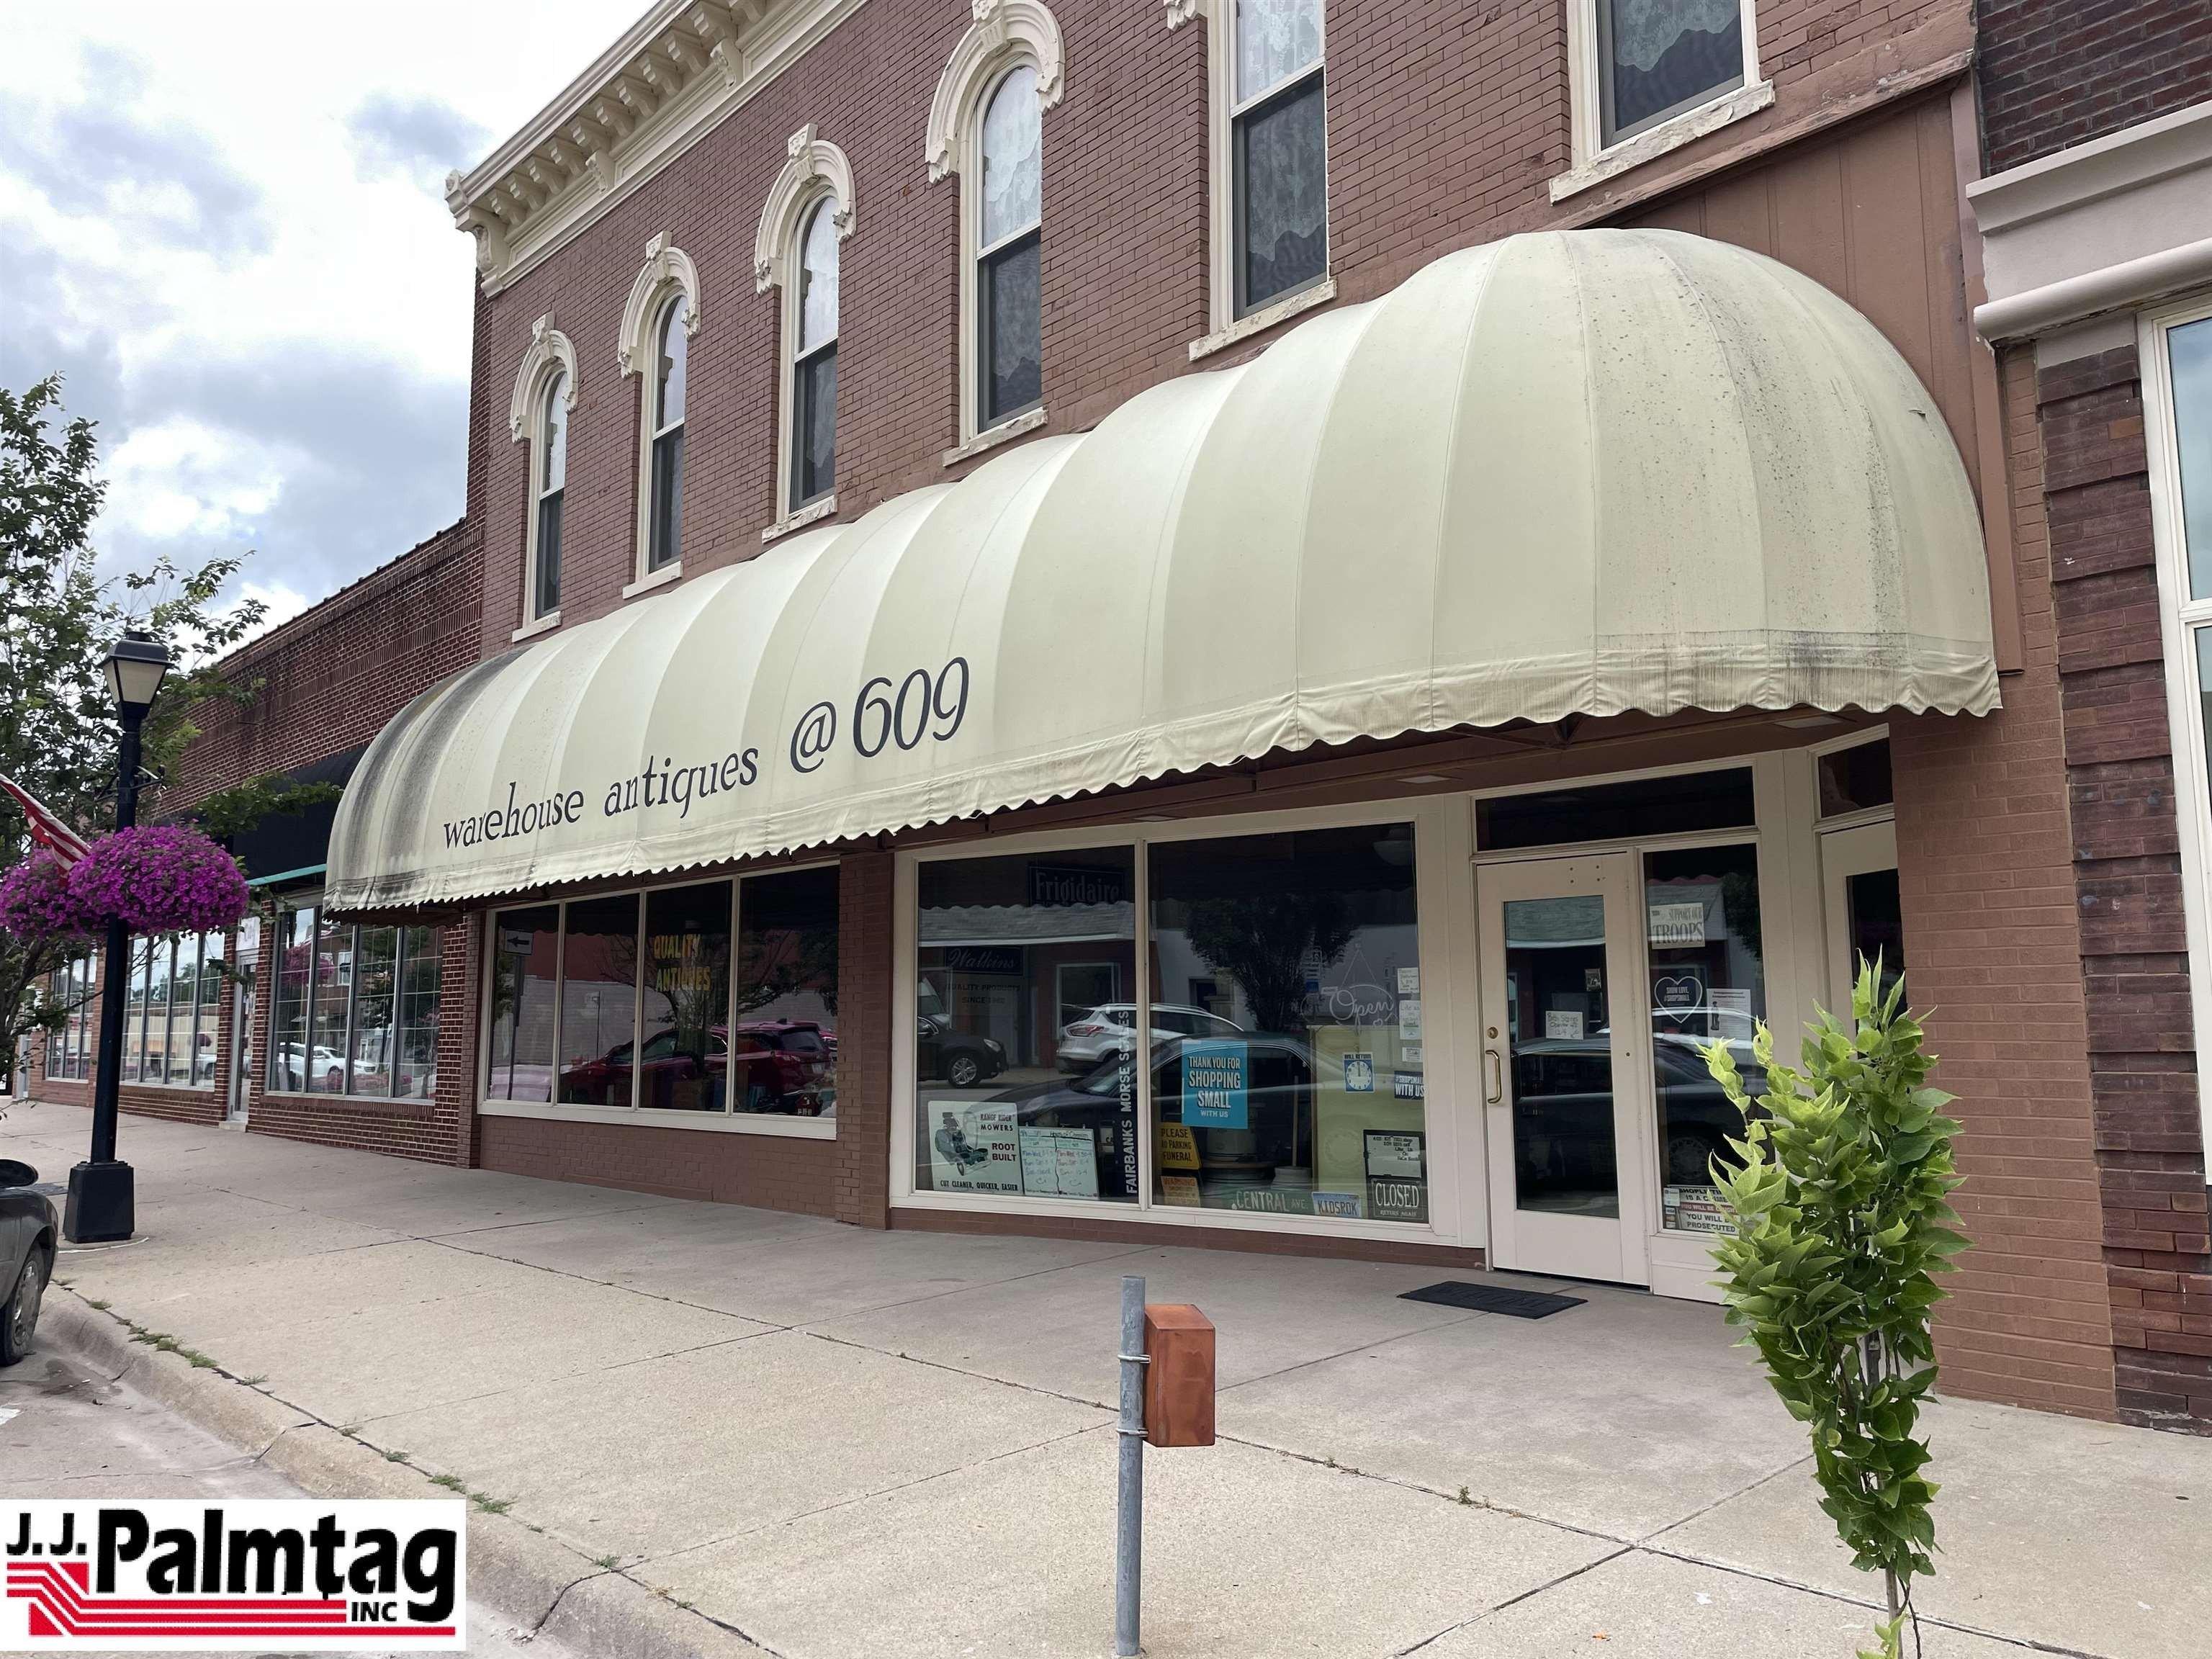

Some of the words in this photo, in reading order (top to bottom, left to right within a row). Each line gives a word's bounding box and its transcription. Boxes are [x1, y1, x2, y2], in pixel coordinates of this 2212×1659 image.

[444, 781, 584, 848] warehouse
[604, 747, 758, 819] antiques
[791, 701, 836, 773] @
[853, 657, 968, 757] 609
[1035, 870, 1120, 905] Frigidaire
[1653, 922, 1703, 944] TROOPS
[654, 934, 701, 958] QUALITY
[948, 946, 1015, 969] Watkins
[656, 966, 711, 991] ANTIQUES
[1329, 989, 1394, 1020] Open
[1118, 1011, 1130, 1061] SCALES
[1188, 1056, 1213, 1069] THANK
[1213, 1057, 1226, 1069] YOU
[1227, 1057, 1241, 1069] FOR
[1119, 1066, 1131, 1112] MORSE
[1188, 1071, 1241, 1089] SHOPPING
[1395, 1075, 1423, 1084] #SHOPSMAL
[1395, 1083, 1413, 1096] WITH
[1415, 1085, 1425, 1097] US
[1197, 1090, 1232, 1109] SMALL
[1161, 1128, 1188, 1138] PLEASE
[992, 1143, 1016, 1151] ROOT
[992, 1153, 1017, 1161] BUILT
[1122, 1119, 1137, 1193] FAIRBANKS
[1163, 1152, 1192, 1161] FUNERAL
[1236, 1191, 1290, 1212] CENTRAL
[1376, 1183, 1419, 1208] CLOSED
[1687, 1221, 1735, 1233] PROSECUTED
